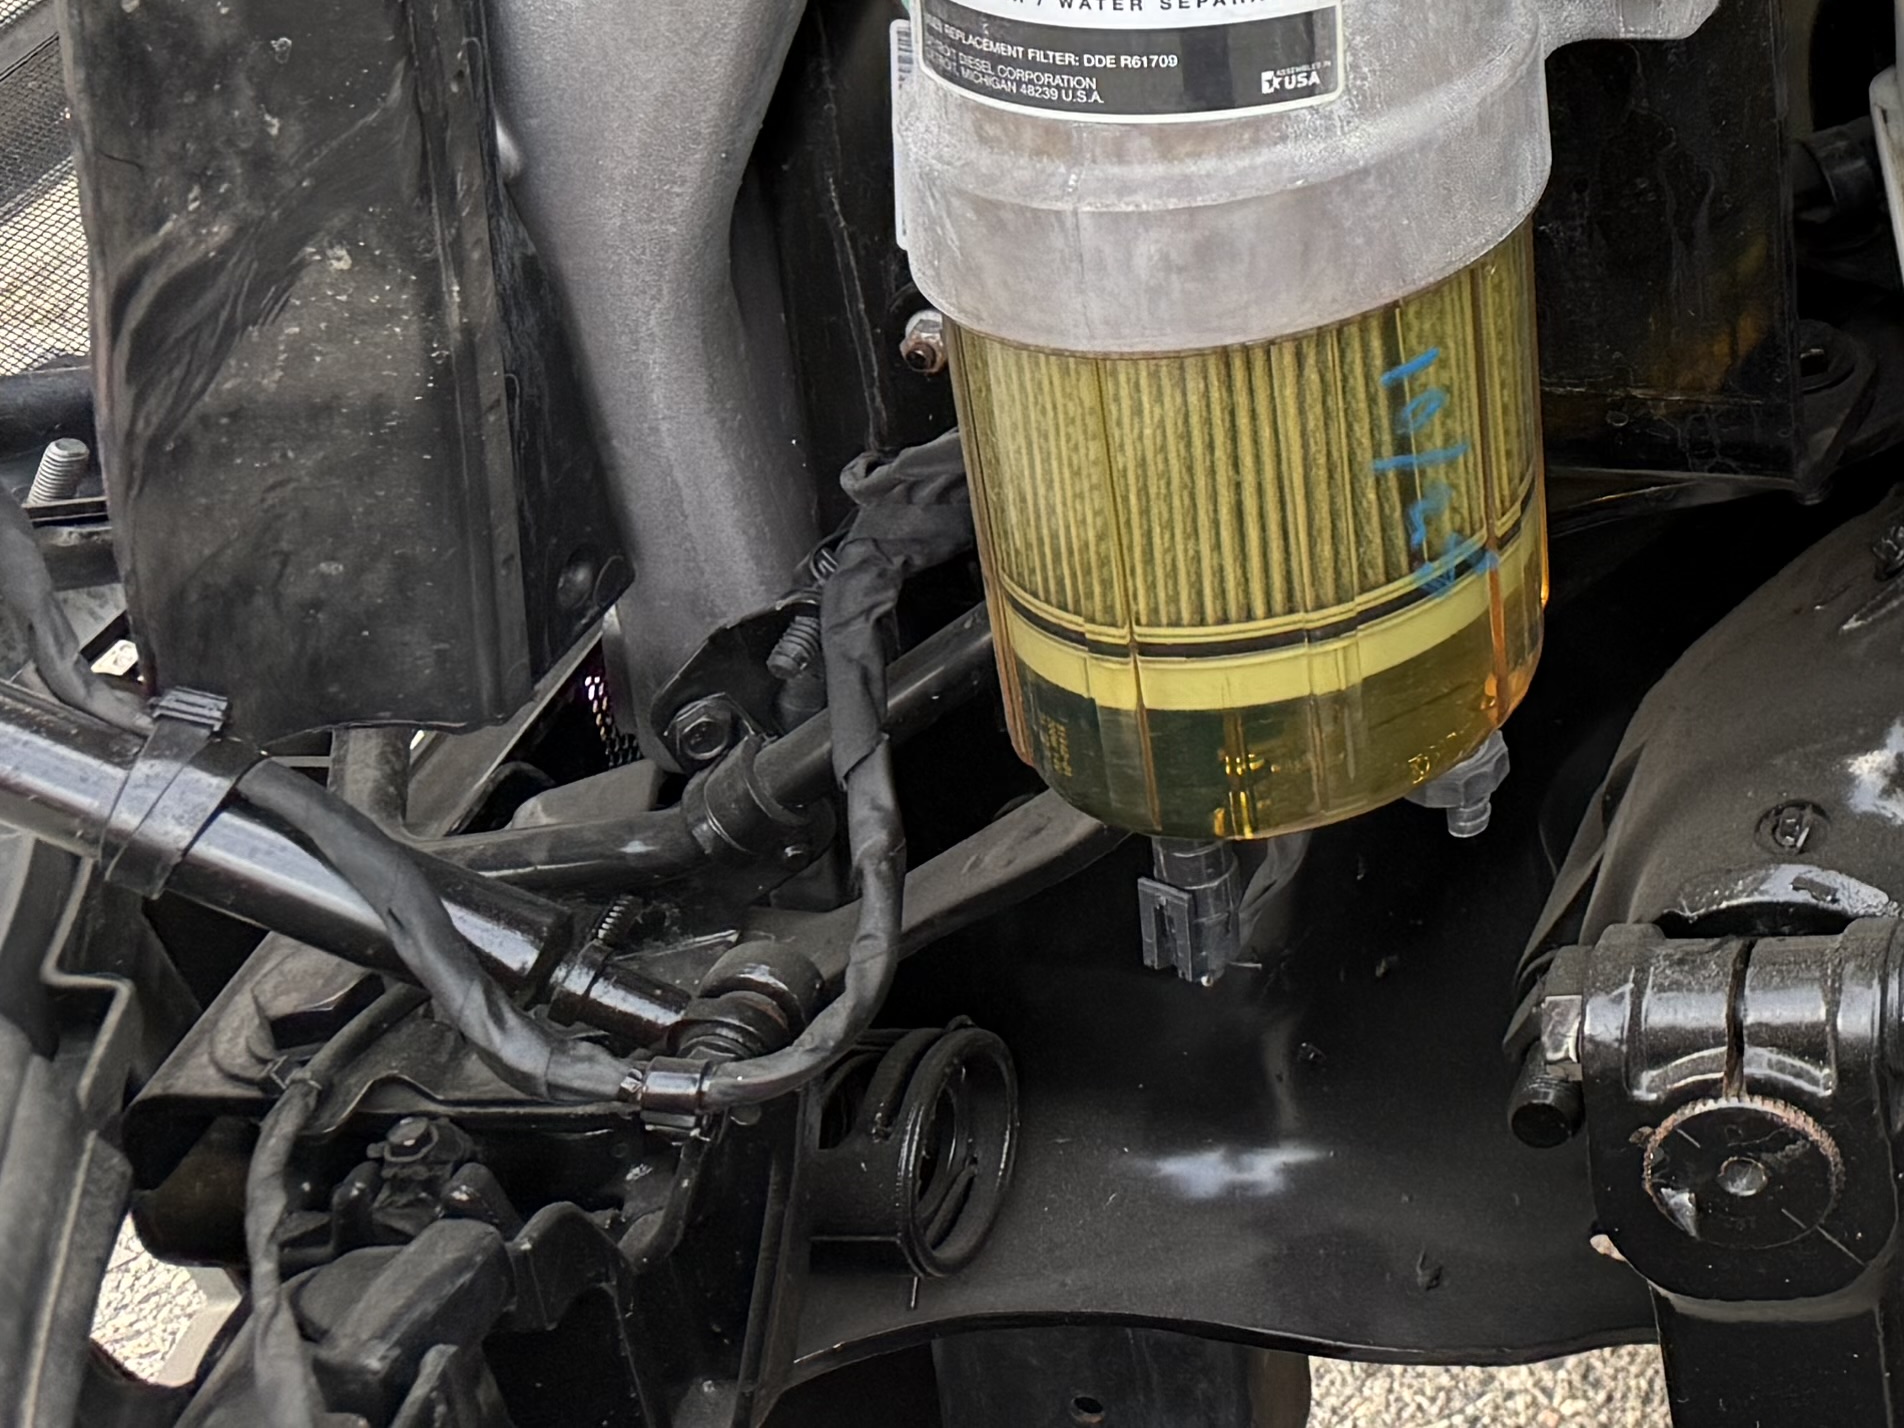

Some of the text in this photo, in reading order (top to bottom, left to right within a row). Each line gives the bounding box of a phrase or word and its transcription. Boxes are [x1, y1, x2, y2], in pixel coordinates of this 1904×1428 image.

[944, 23, 1024, 60] REPLACEMENT
[1028, 49, 1080, 66] FILTER:
[1083, 55, 1116, 68] DDE
[1120, 54, 1178, 69] R61709
[959, 49, 1097, 90] DIESEL CORPORATION
[960, 66, 1104, 104] MICHIGAN 48239 U.S.A.
[1284, 71, 1320, 89] USA
